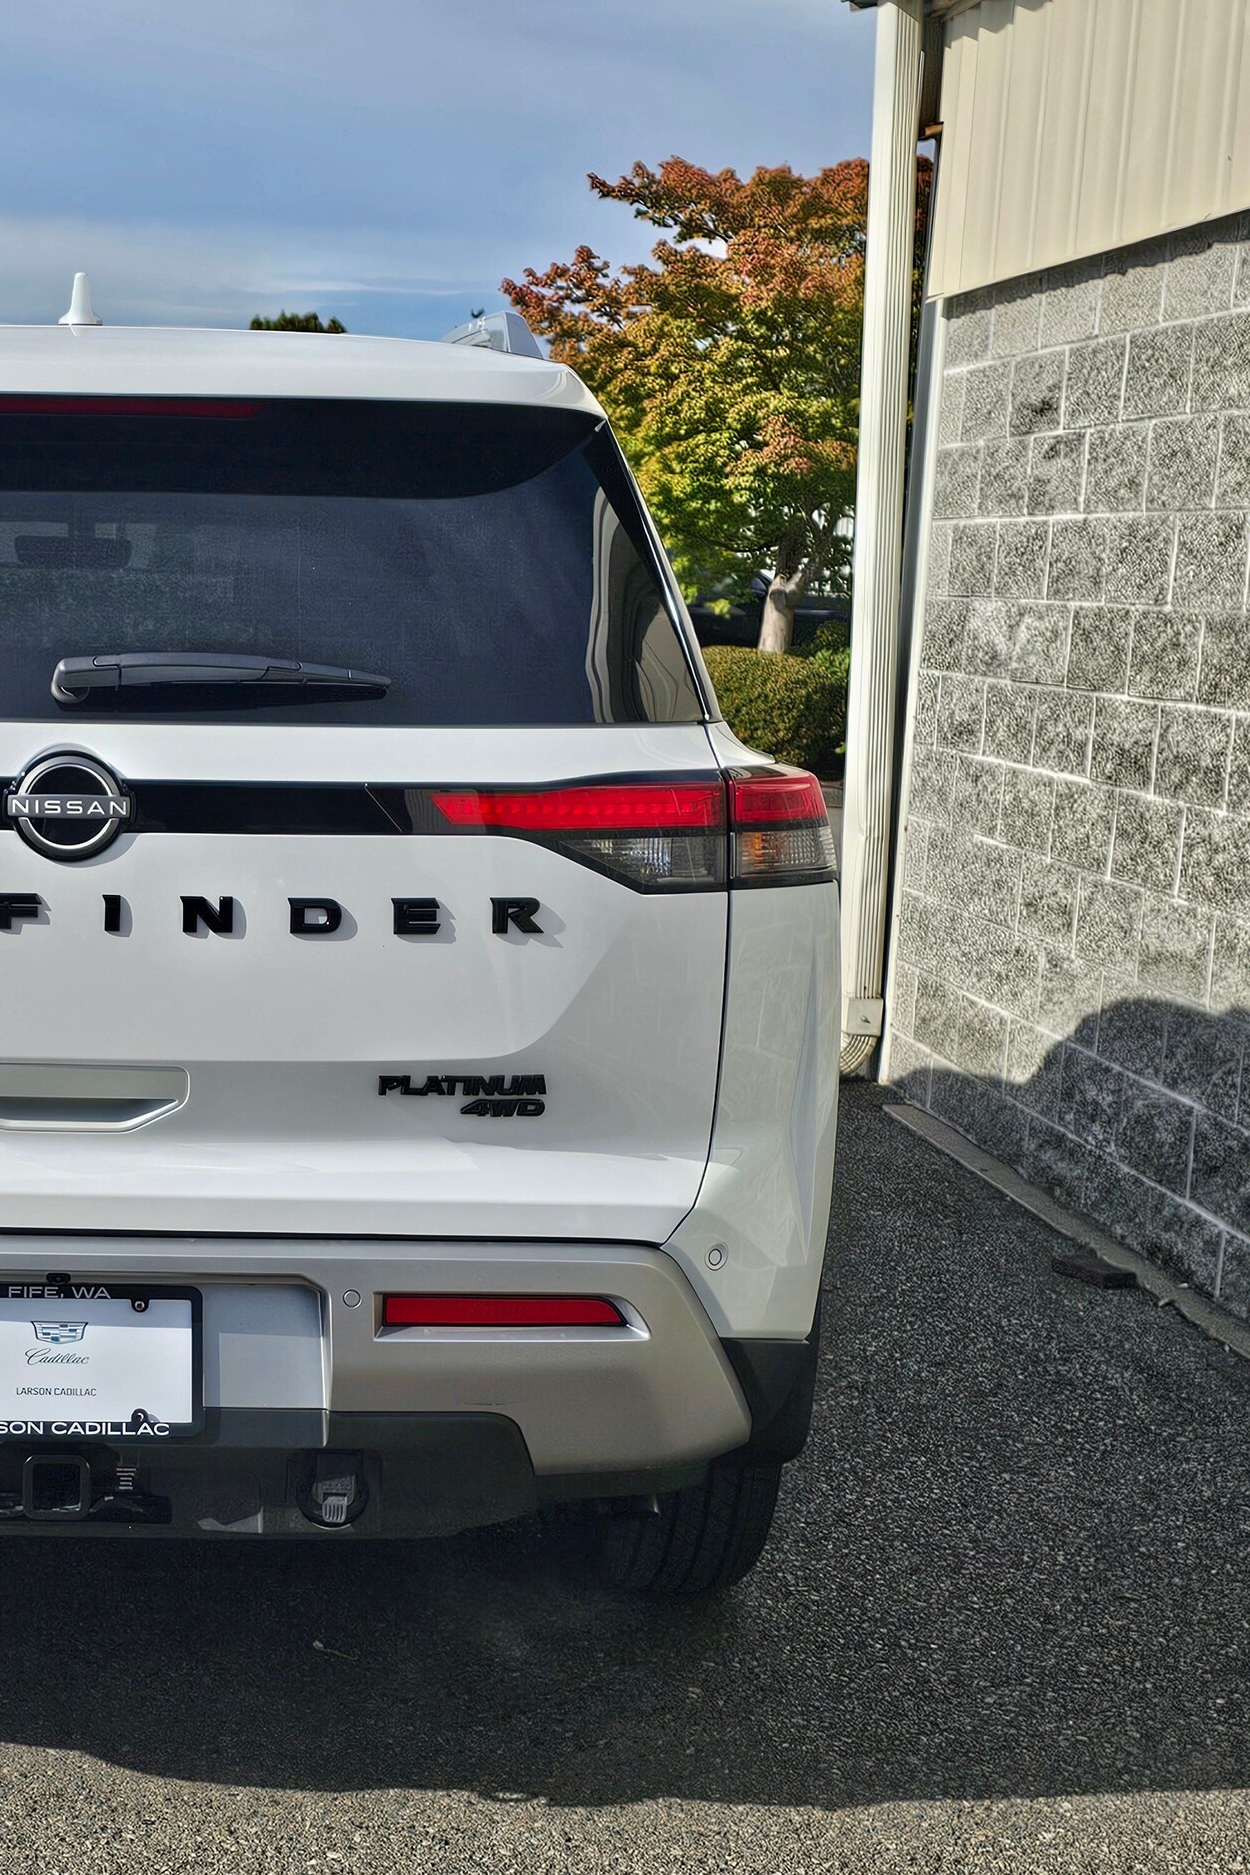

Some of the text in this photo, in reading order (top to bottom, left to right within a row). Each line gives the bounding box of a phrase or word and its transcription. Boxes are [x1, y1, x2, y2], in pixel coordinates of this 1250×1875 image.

[11, 799, 127, 816] NISSAN
[378, 1074, 547, 1096] PLATINUM
[460, 1098, 546, 1118] 4WD
[8, 1286, 112, 1300] FIFE, WA
[24, 1347, 90, 1366] Cadillac
[15, 1386, 97, 1397] LARSON CADILLAC
[51, 1421, 171, 1437] CADILLAC
